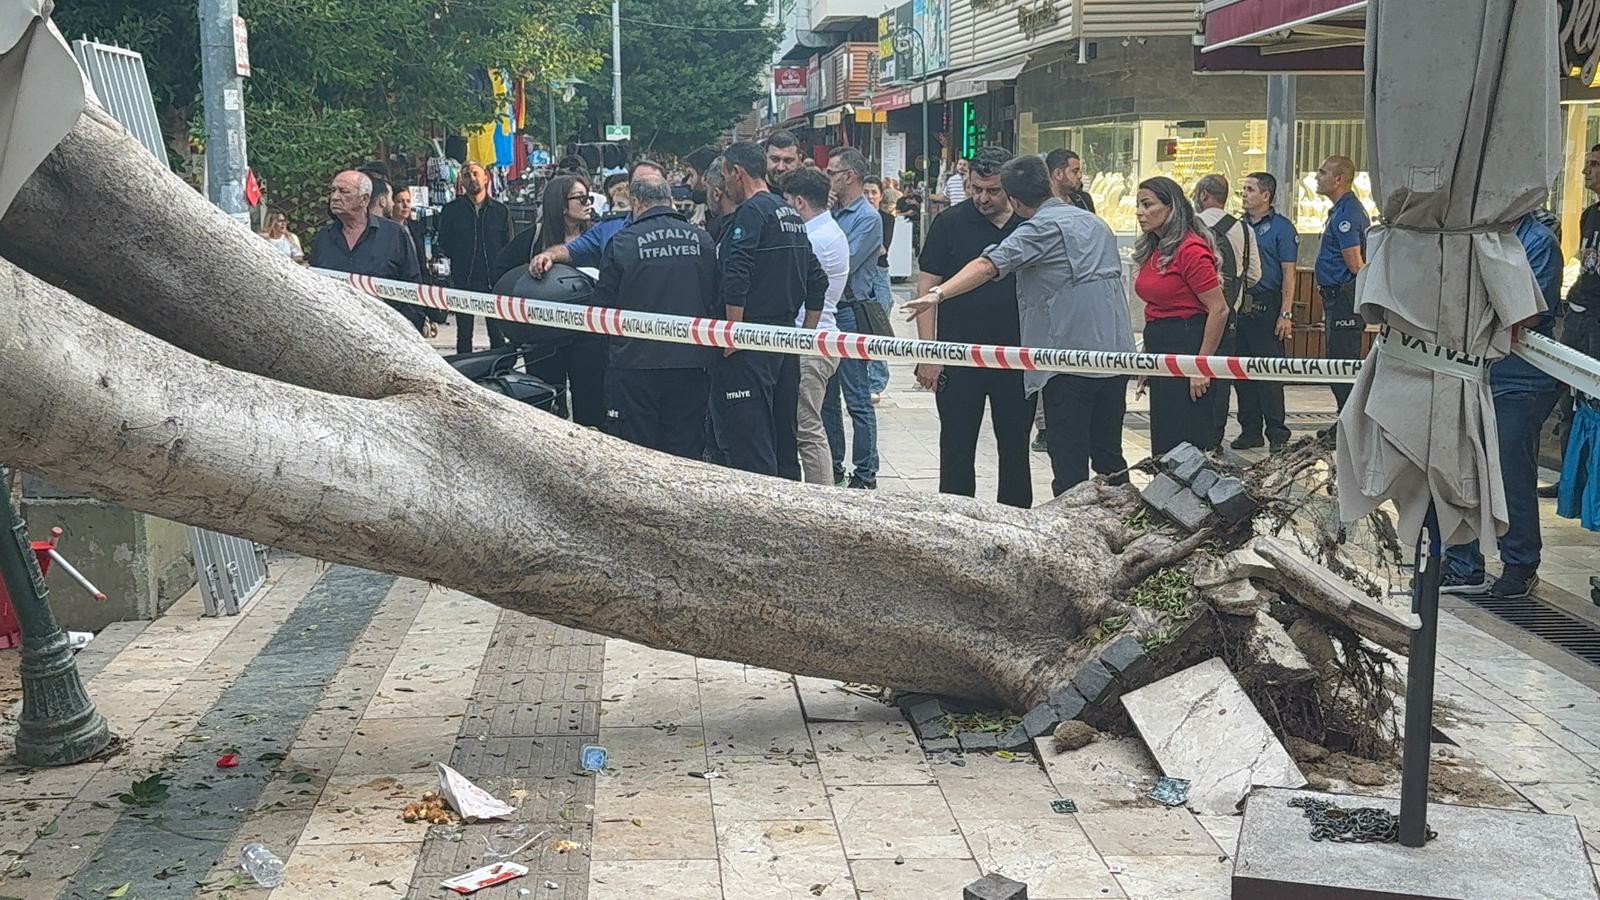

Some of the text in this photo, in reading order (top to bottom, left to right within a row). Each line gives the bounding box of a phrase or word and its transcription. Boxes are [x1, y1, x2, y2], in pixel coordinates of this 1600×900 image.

[637, 228, 700, 247] ANTALYA
[639, 243, 701, 260] İTFAİYESİ
[446, 295, 469, 309] ANTALYA
[527, 306, 555, 323] ANTALYA
[622, 318, 691, 338] ANTALYA İTFAİYESİ
[733, 328, 817, 350] ANTALYA İTFAİYESİ
[868, 339, 915, 358] ANTALYA
[1034, 349, 1092, 368] ANTALYA
[1247, 358, 1323, 375] ANTALYA
